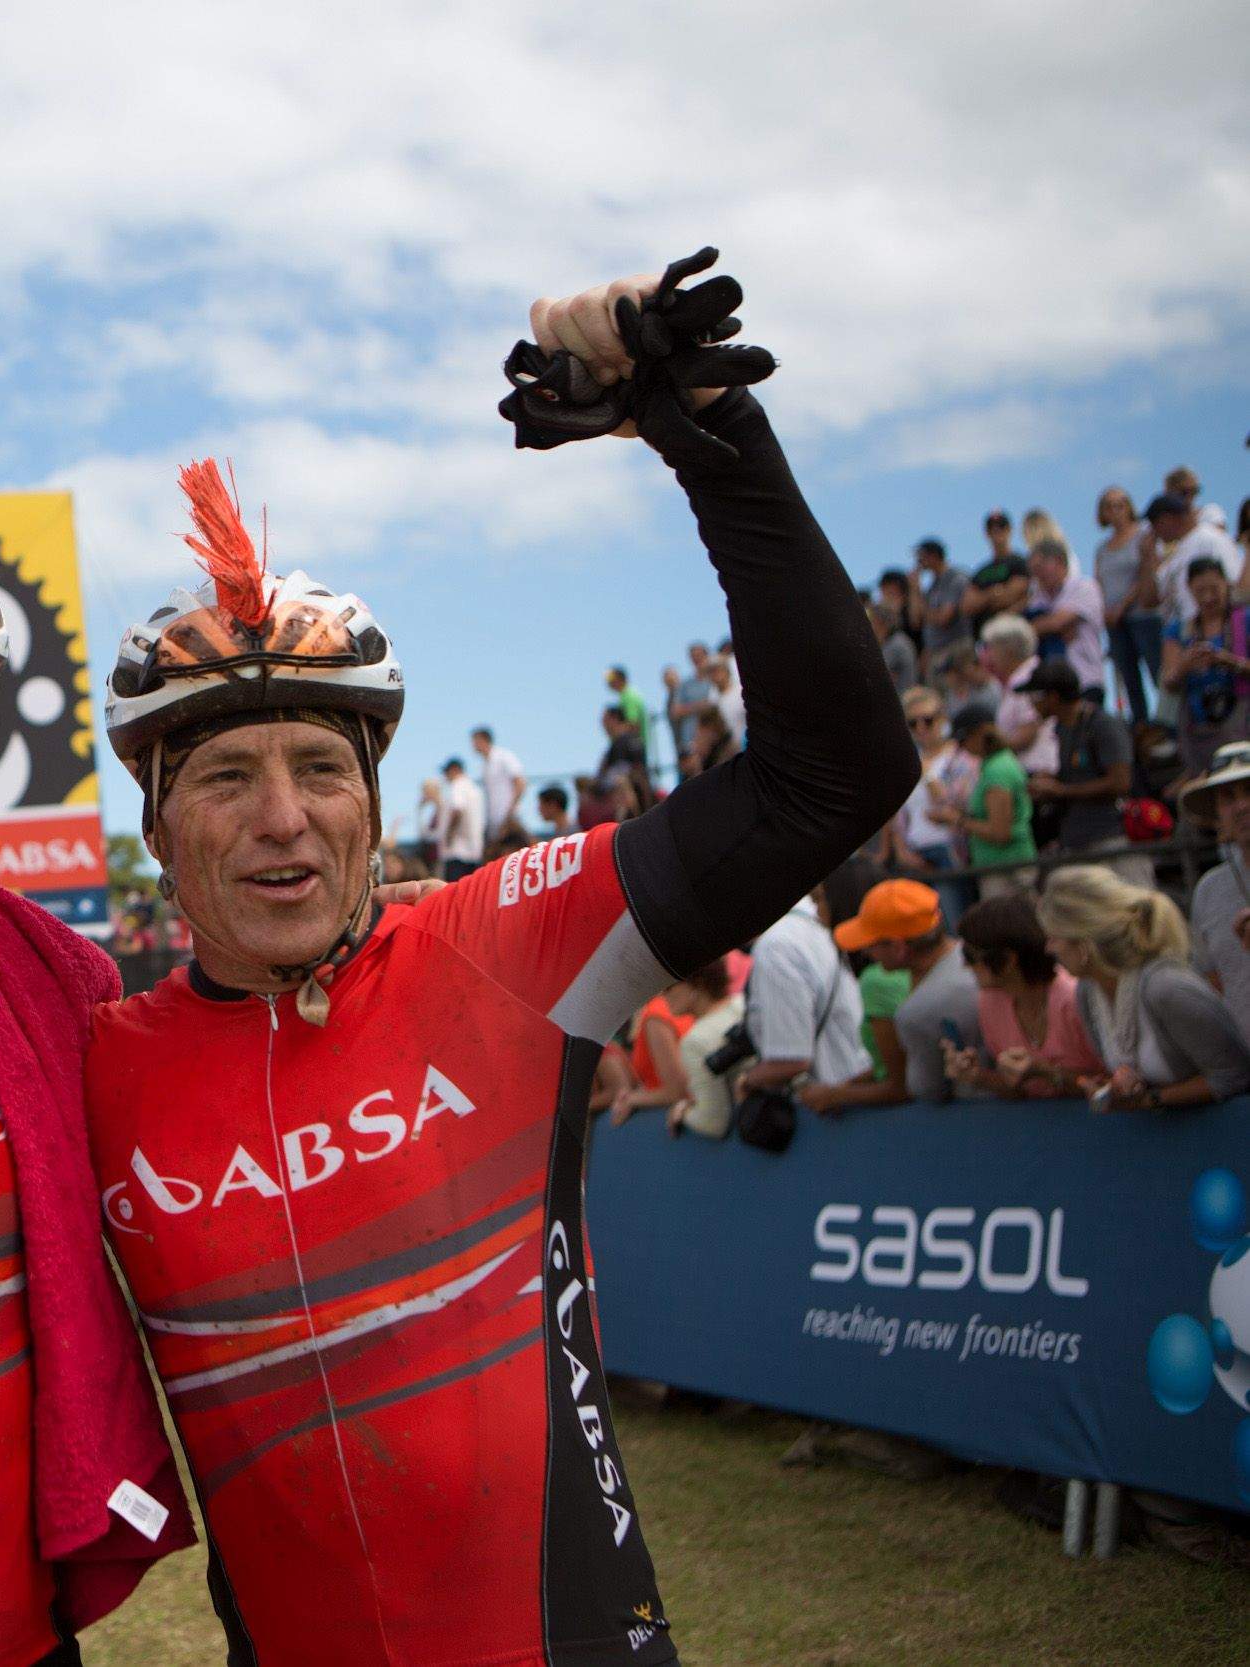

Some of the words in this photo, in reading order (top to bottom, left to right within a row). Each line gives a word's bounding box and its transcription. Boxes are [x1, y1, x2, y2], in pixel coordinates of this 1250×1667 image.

[211, 1063, 477, 1209] ABSA
[802, 1303, 901, 1357] reaching
[903, 1319, 957, 1351] new
[957, 1312, 1083, 1364] frontiers
[562, 1345, 632, 1549] ABSA
